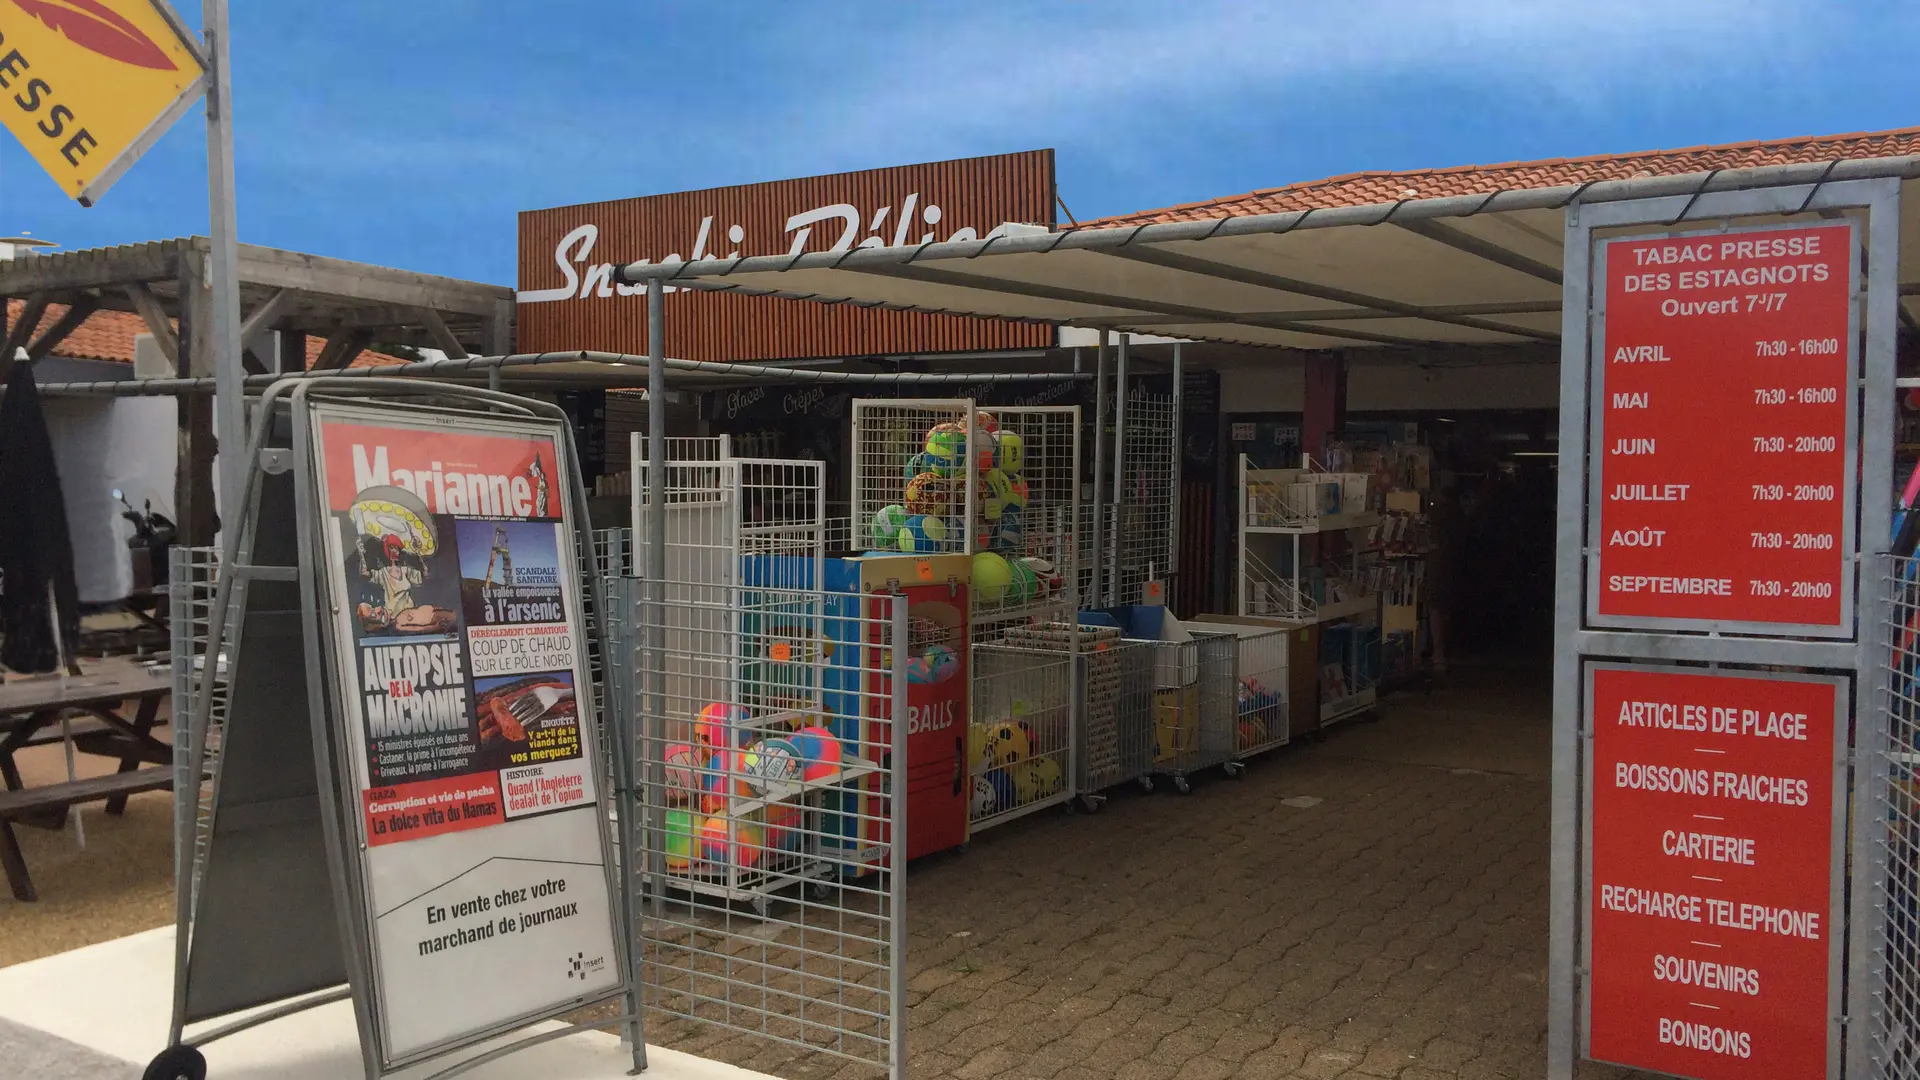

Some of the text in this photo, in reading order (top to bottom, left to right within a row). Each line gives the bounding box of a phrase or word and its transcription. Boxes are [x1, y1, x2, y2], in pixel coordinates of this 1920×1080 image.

[0, 30, 98, 168] ESSE
[1633, 236, 1821, 266] TABAC PRESSE
[1624, 263, 1830, 293] DES ESTAGNOTS
[1661, 296, 1738, 317] Ouvert
[1613, 345, 1671, 364] AVRIL
[1755, 340, 1787, 357] 7h30
[1798, 338, 1838, 355] 16h00
[726, 385, 766, 419] Glaces
[783, 385, 825, 415] Crêpes
[1613, 392, 1648, 409] MAI
[1754, 389, 1786, 405] 7h30
[1797, 387, 1837, 404] 16h00
[1611, 438, 1655, 455] JUIN
[1753, 437, 1785, 453] 7h30
[1795, 436, 1836, 453] 20h00
[352, 444, 532, 517] Marianne
[1610, 484, 1690, 501] JUILLET
[1752, 485, 1783, 501] 7h30
[1794, 484, 1835, 501] 20h00
[1609, 525, 1666, 547] AOÛT
[1751, 532, 1782, 549] 7h30
[1793, 533, 1833, 550] 20h00
[515, 567, 557, 576] SCANDALE
[516, 575, 558, 584] SANITAIRE
[482, 586, 560, 599] La vallée empoisonnée
[1609, 575, 1732, 596] SEPTEMBRE
[1750, 580, 1781, 597] 7h30
[1792, 581, 1832, 598] 20h00
[484, 597, 561, 622] à l'arsenic
[525, 625, 568, 635] CLIMATIQUE
[473, 636, 571, 656] COUP DE CHAUD
[363, 642, 464, 692] AUTOPSIE
[474, 653, 573, 672] SUR LE PÔLE NORD
[389, 680, 413, 698] DE LA
[366, 687, 469, 739] MACRONIE
[1618, 700, 1807, 741] ARTICLES DE PLAGE
[385, 738, 413, 751] ministres
[413, 735, 435, 748] épuisés
[436, 736, 444, 744] en
[444, 734, 458, 743] deux
[458, 733, 469, 742] ans
[528, 730, 534, 740] Y
[557, 728, 567, 737] de
[568, 727, 576, 735] la
[529, 735, 577, 749] viande dans
[406, 750, 413, 759] la
[413, 749, 430, 762] prime
[408, 763, 415, 773] la
[415, 762, 432, 775] prime
[437, 757, 469, 770] l'arrogance
[510, 753, 528, 763] vos
[530, 747, 571, 760] merguez
[506, 767, 544, 780] HISTOIRE
[507, 774, 582, 797] Quand l'Angleterre
[1615, 762, 1809, 807] BOISSONS FRAICHES
[369, 789, 396, 800] GAZA
[369, 796, 426, 814] Corruption
[427, 795, 437, 804] et
[438, 791, 453, 803] vie
[454, 789, 466, 800] de
[509, 787, 583, 811] dealait de l'opium
[372, 801, 497, 835] La dolce vita du Hamas
[1662, 830, 1755, 866] CARTERIE
[426, 878, 567, 925] En vente chez votre
[1601, 884, 1820, 940] RECHARGE TELEPHONE
[418, 901, 578, 956] marchand de journaux
[1653, 953, 1760, 996] SOUVENIRS
[1659, 1017, 1751, 1059] BONBONS
